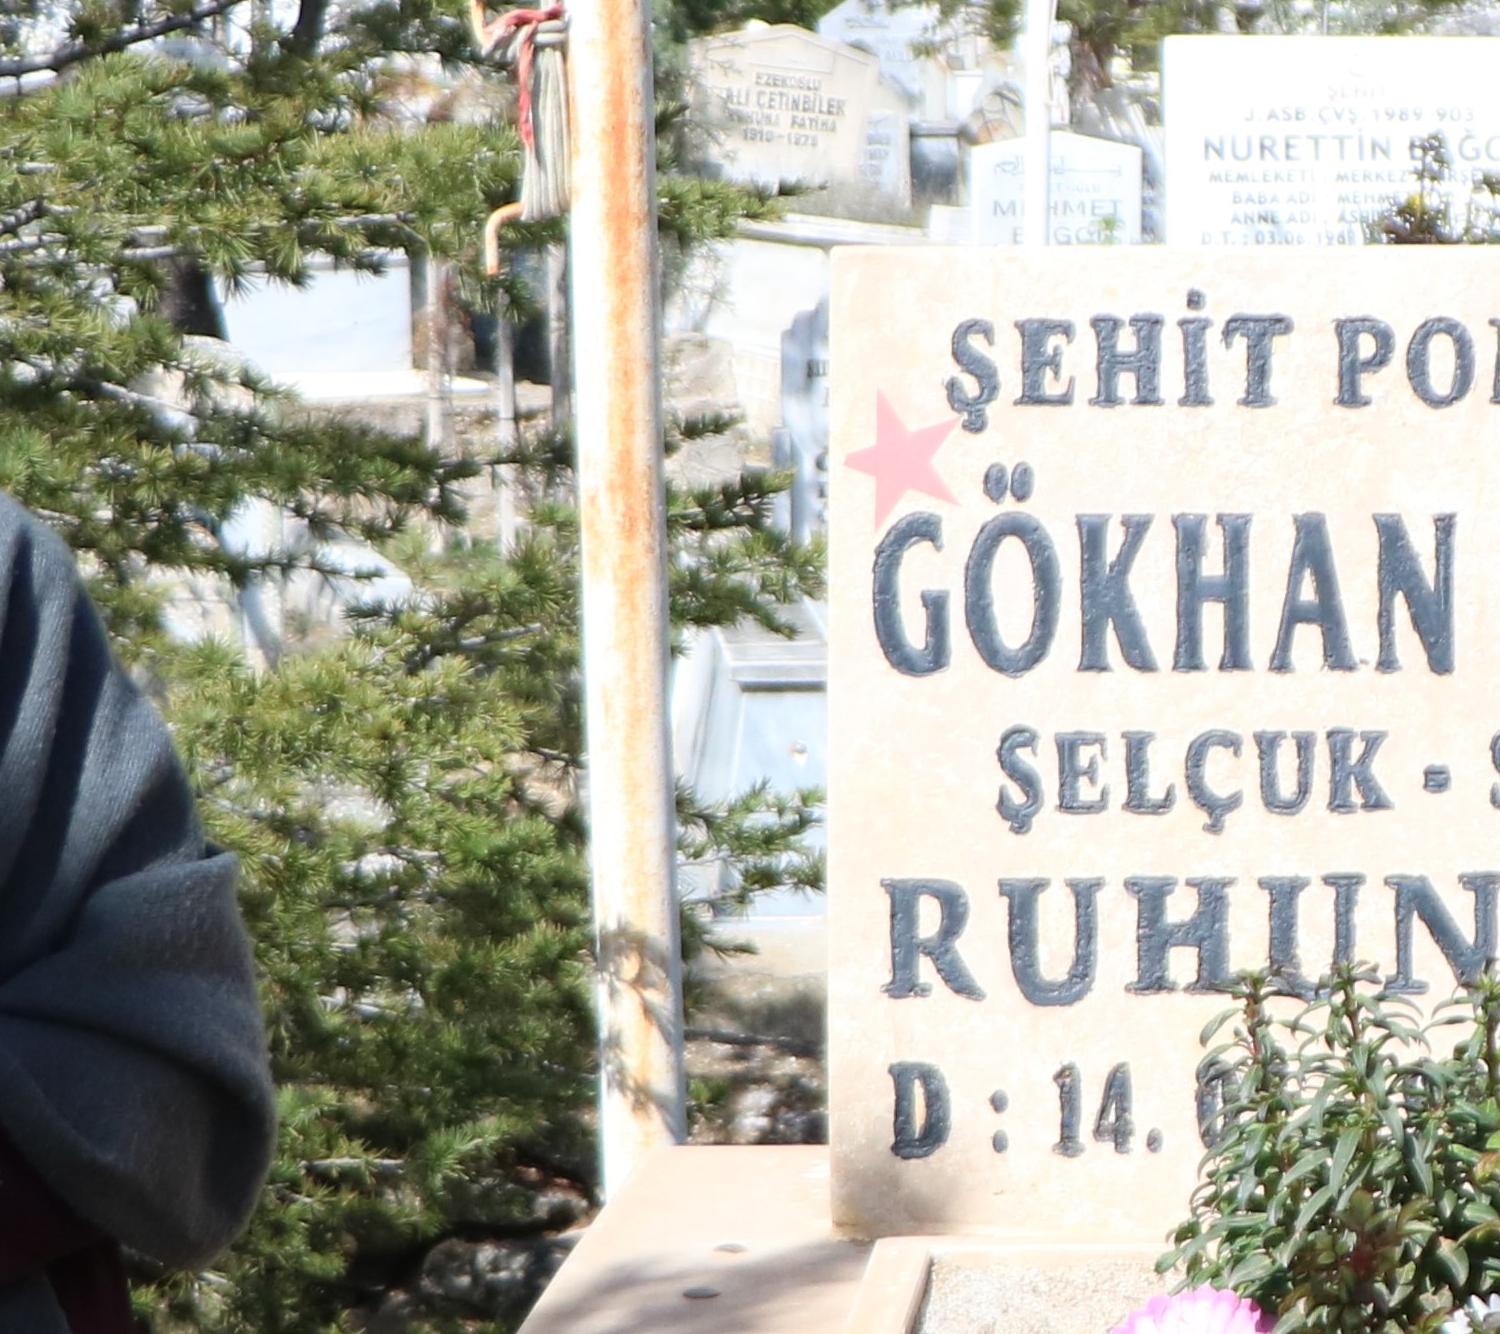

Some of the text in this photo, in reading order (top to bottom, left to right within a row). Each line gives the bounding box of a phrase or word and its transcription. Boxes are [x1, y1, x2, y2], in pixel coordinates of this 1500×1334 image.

[1203, 128, 1392, 163] NURETTİN
[945, 288, 1295, 434] ŞEHİT
[872, 460, 1458, 678] GÖKHAN
[994, 723, 1396, 836] ŞELÇUK
